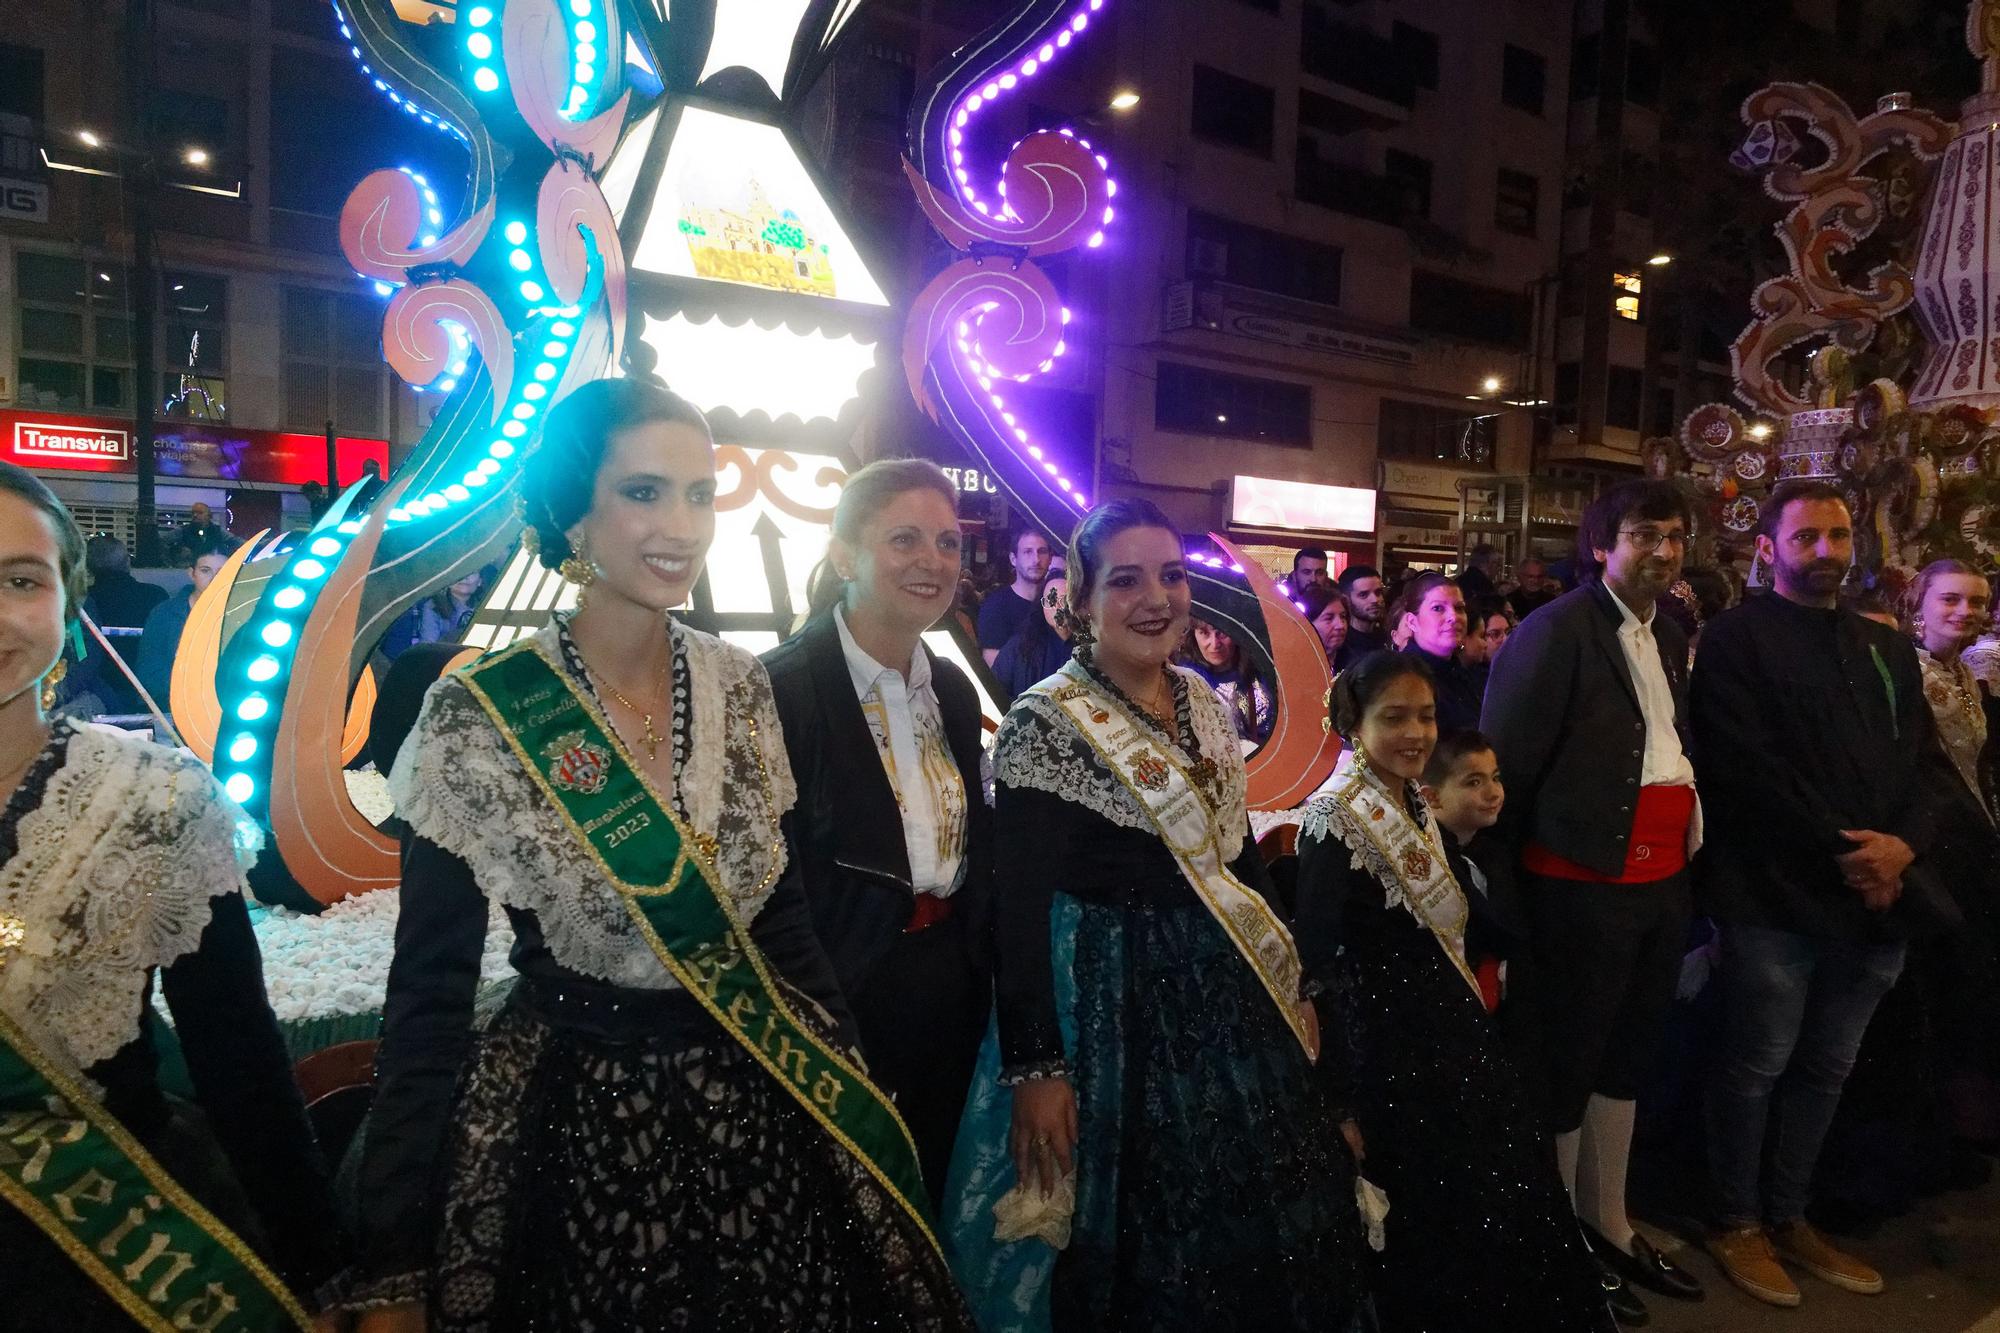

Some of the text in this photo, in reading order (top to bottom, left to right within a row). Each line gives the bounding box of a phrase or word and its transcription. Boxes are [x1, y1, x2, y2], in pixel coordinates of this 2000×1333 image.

[24, 429, 120, 454] Transvia
[603, 811, 652, 849] 2023
[680, 930, 844, 1116] Reina
[0, 1095, 239, 1333] Reina
